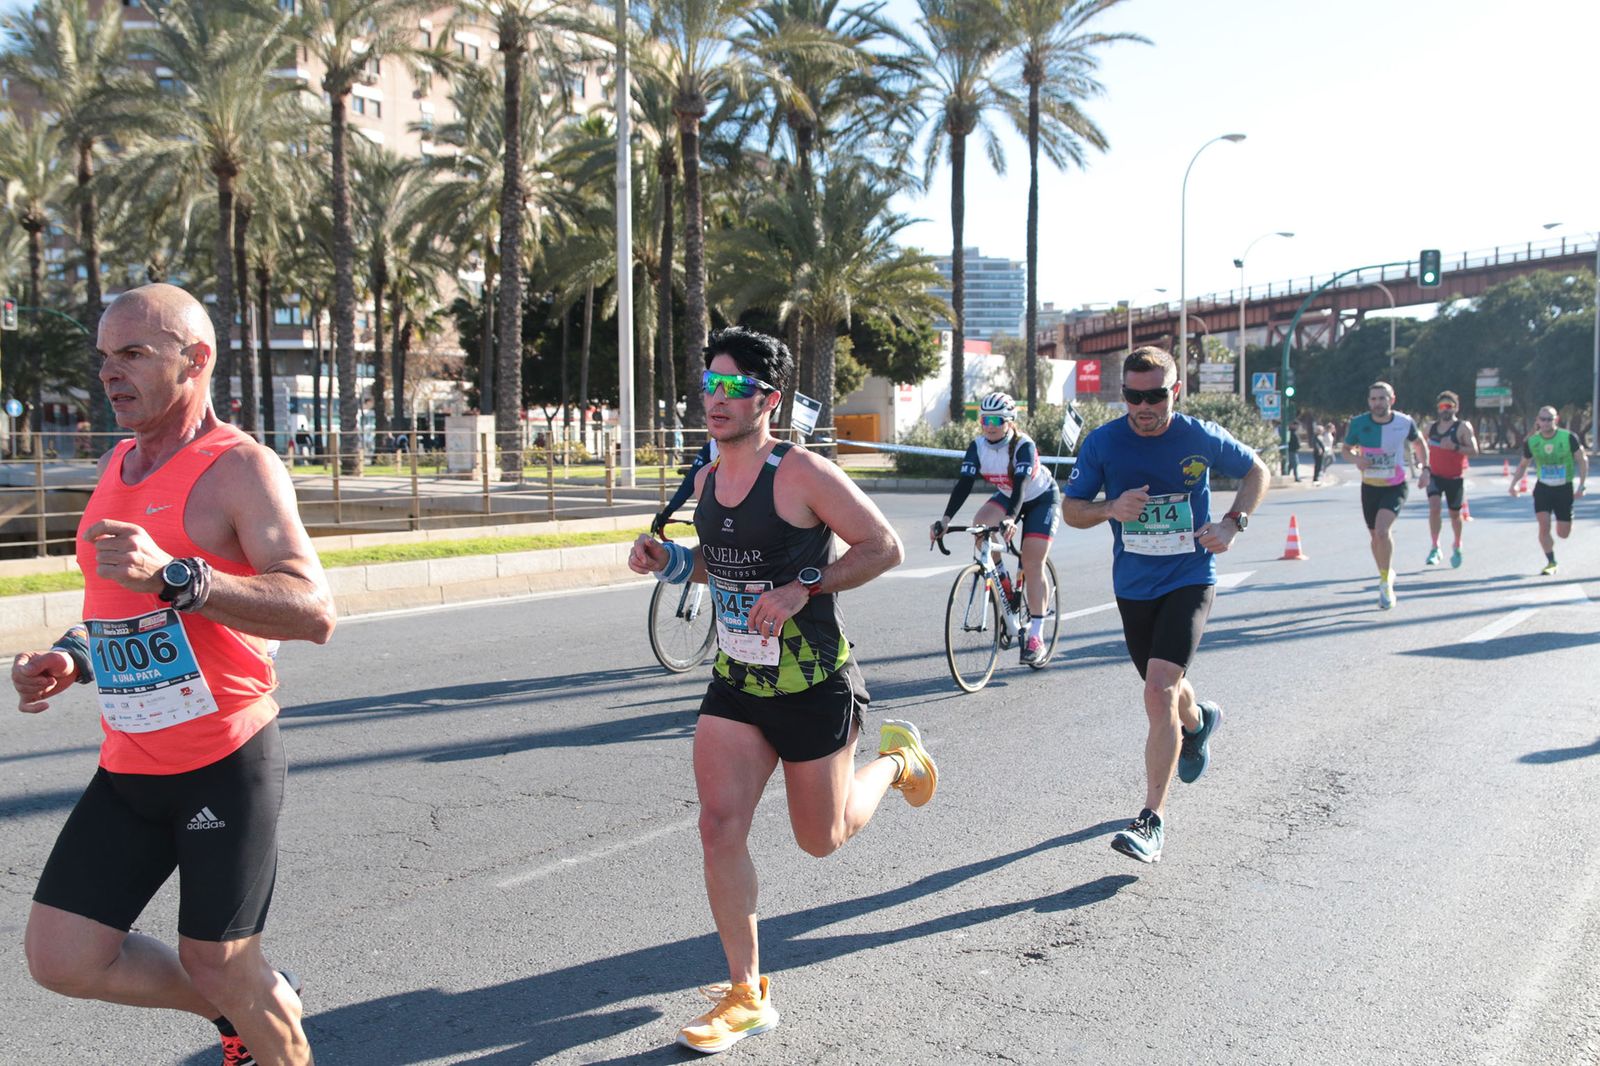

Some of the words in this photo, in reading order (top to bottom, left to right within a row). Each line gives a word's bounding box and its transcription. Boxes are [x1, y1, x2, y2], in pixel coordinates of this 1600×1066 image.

[96, 631, 179, 673] 1006
[112, 674, 118, 683] A
[119, 672, 134, 682] UNA
[136, 668, 162, 681] PATA
[186, 820, 226, 830] adidas
